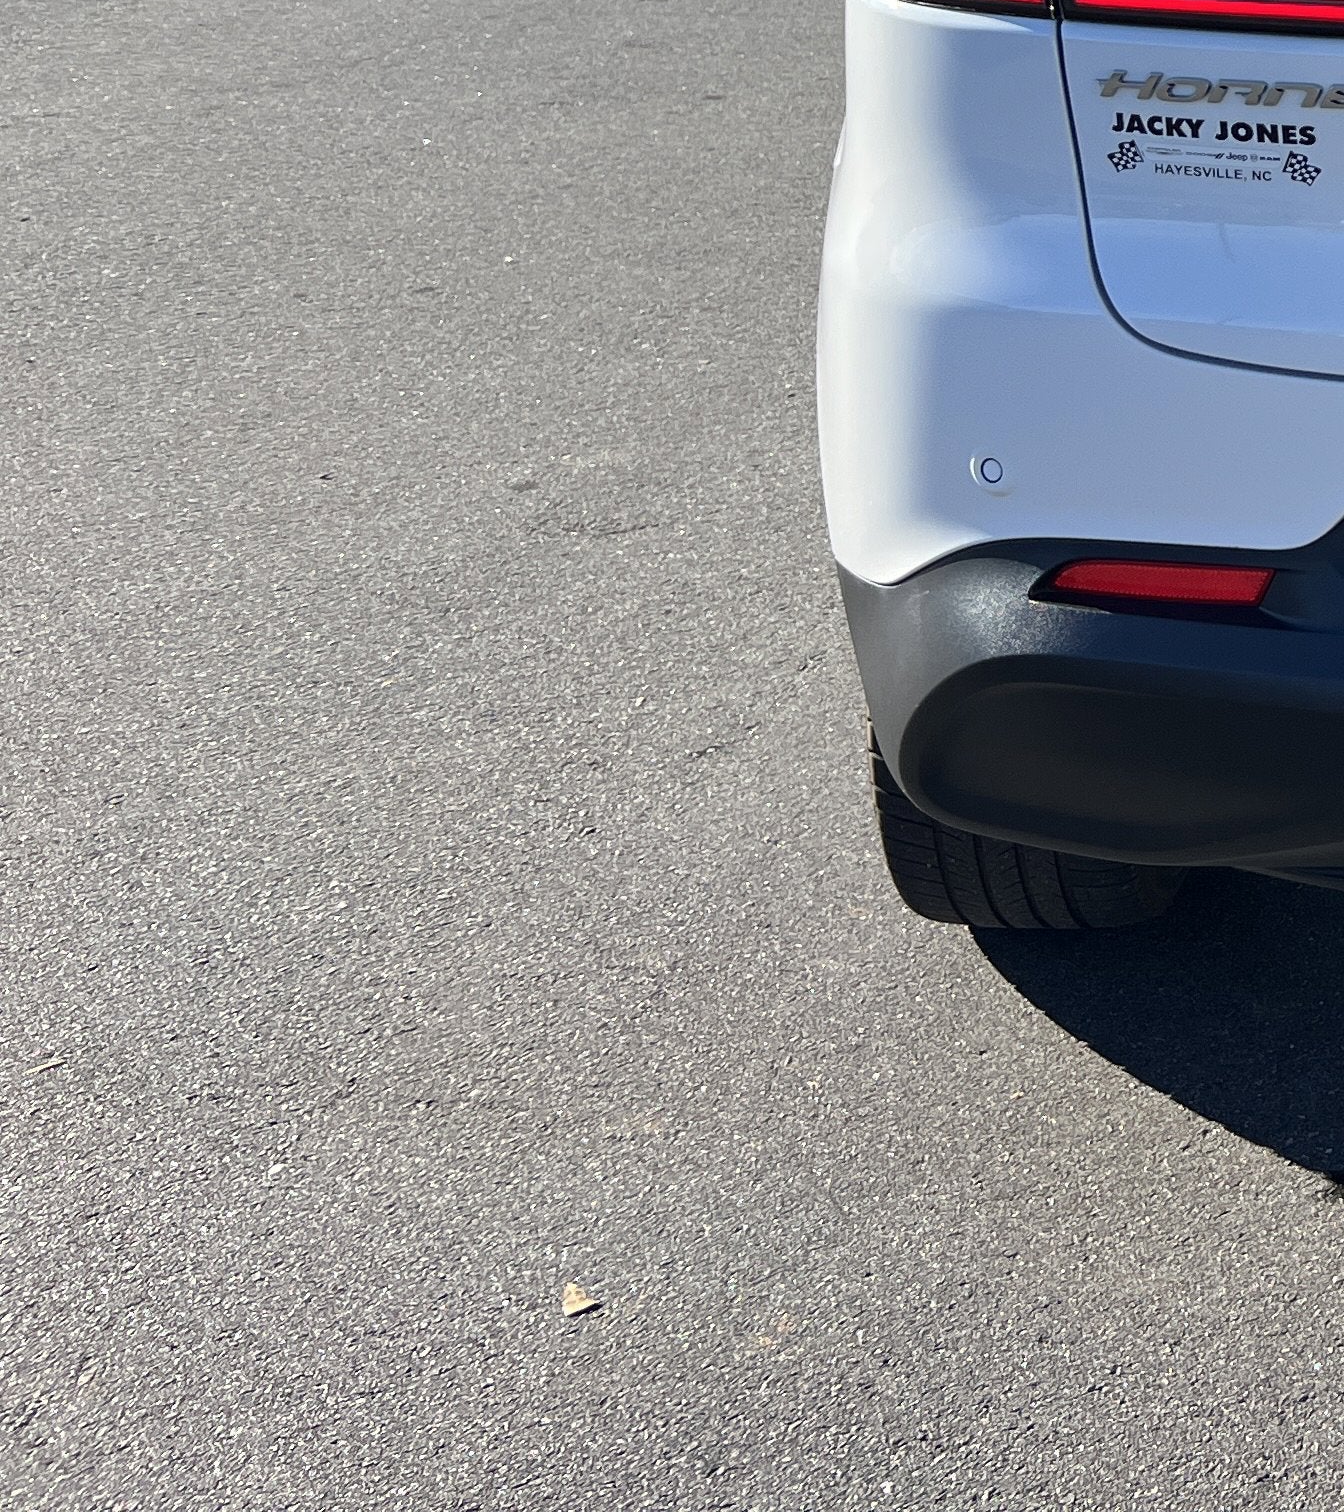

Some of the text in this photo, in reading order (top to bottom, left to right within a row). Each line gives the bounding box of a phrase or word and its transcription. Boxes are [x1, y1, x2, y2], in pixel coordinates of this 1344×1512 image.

[1111, 112, 1318, 147] JACKY JONES
[1226, 152, 1249, 162] Jeep
[1154, 162, 1273, 182] HAYESVILLE, NC
